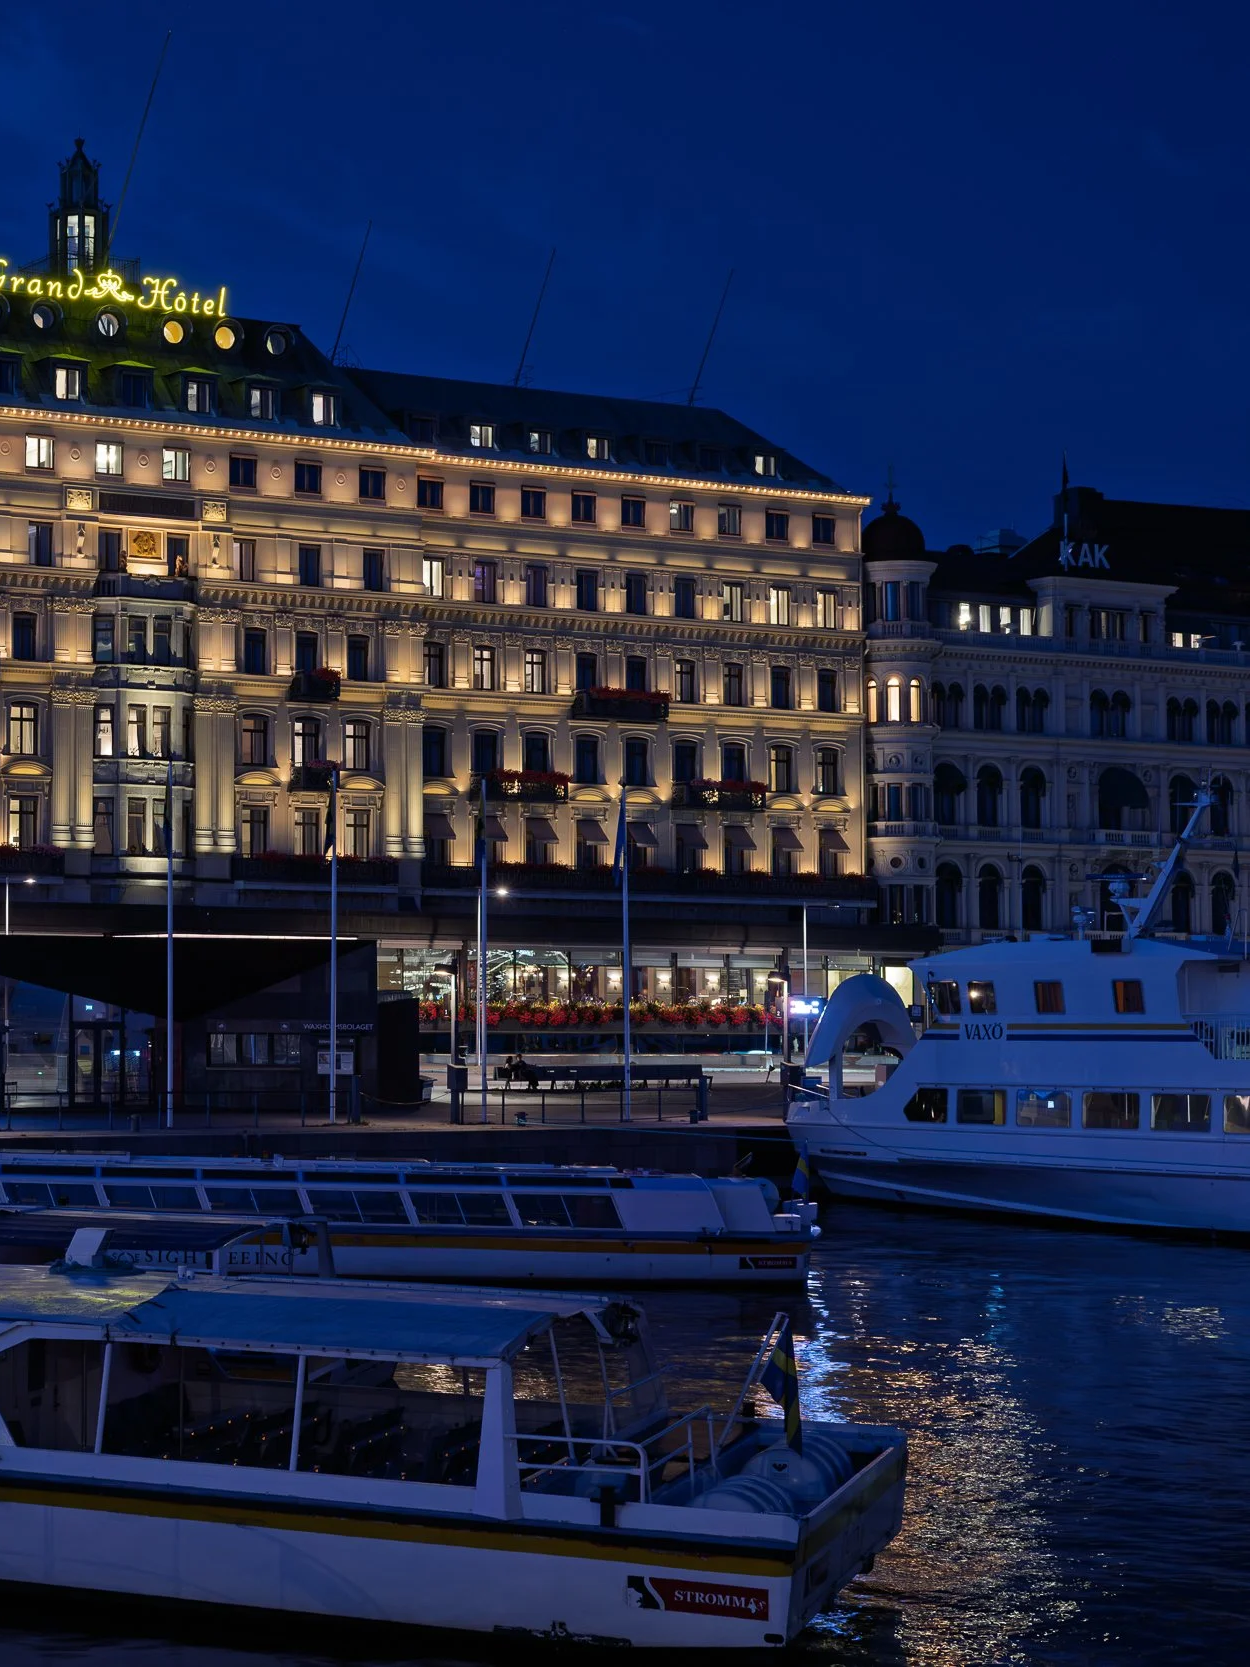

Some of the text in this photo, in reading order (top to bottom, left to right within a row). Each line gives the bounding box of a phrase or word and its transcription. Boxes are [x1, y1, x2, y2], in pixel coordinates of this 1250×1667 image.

[137, 276, 227, 317] Hôtel
[1059, 541, 1110, 570] KAK
[964, 1022, 1003, 1040] VAXÖ
